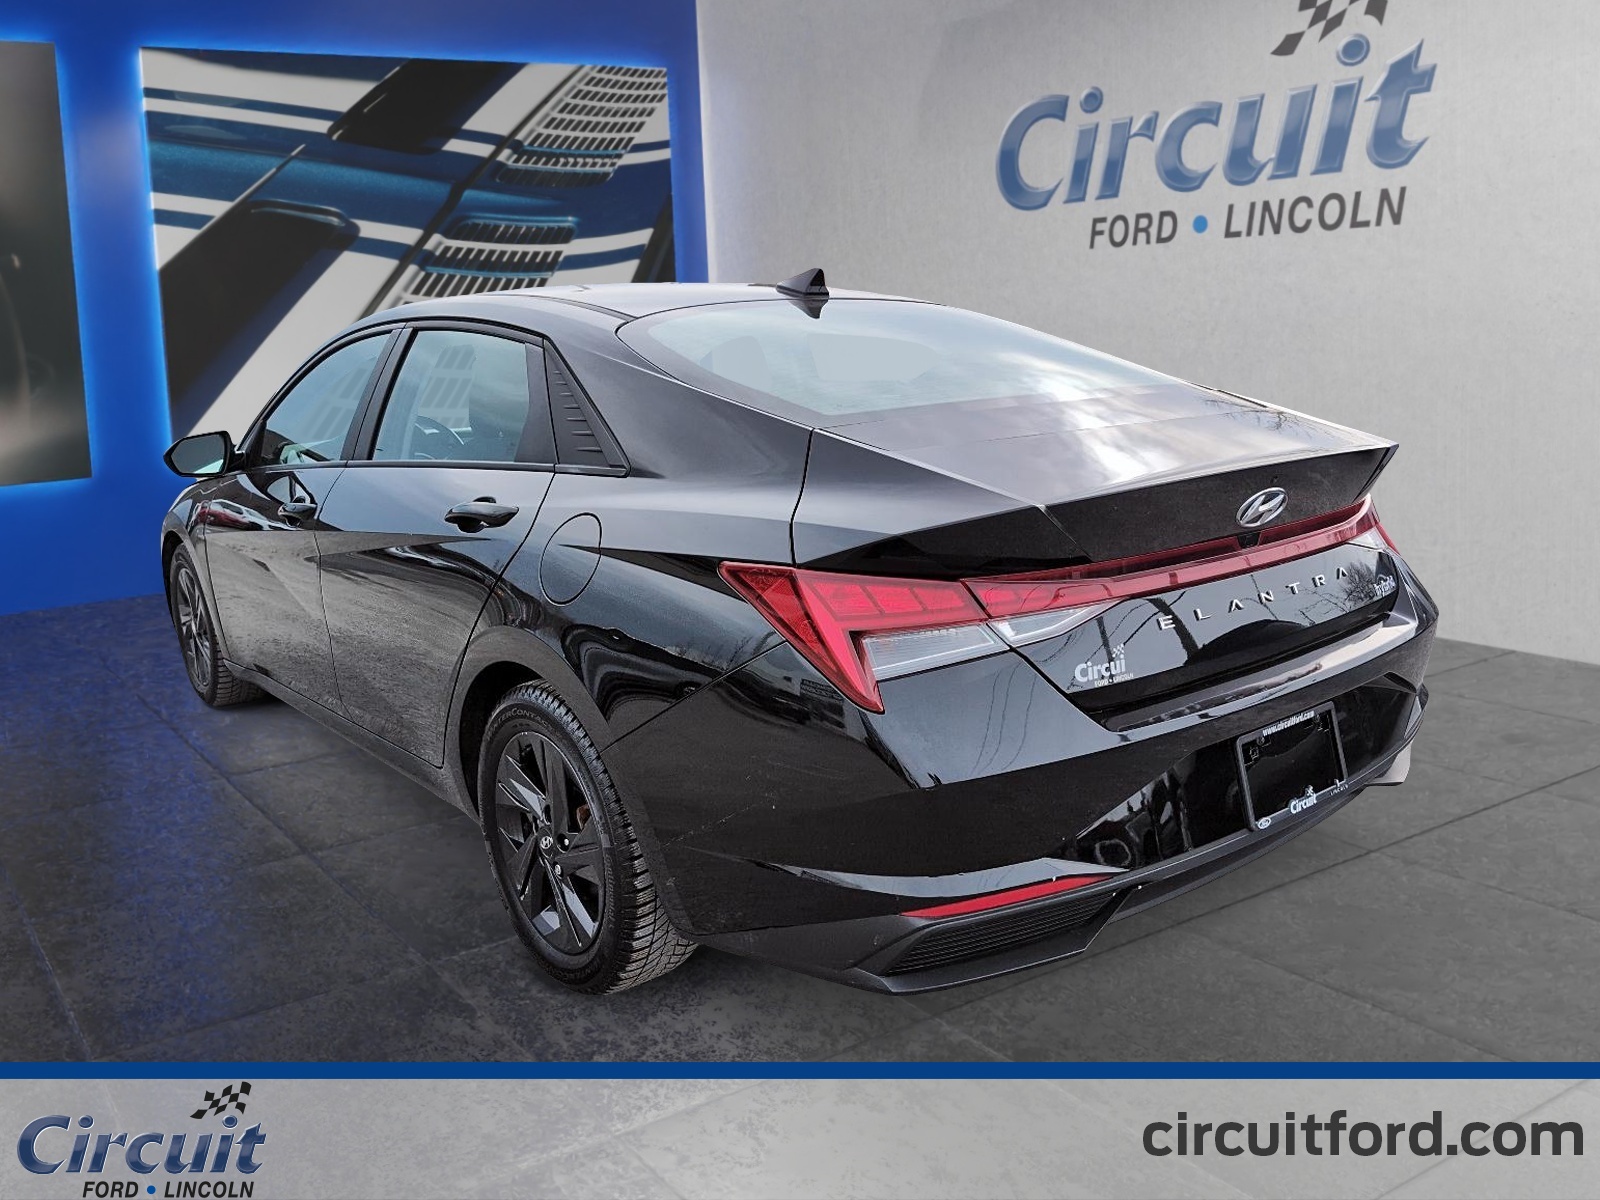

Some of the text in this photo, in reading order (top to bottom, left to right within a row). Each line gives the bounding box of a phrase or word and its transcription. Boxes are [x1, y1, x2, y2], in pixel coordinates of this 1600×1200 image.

[995, 33, 1437, 211] Circuit
[1089, 186, 1407, 249] FORD LINCOLN
[1158, 566, 1349, 631] ELANTRA
[1290, 793, 1317, 814] Circuit
